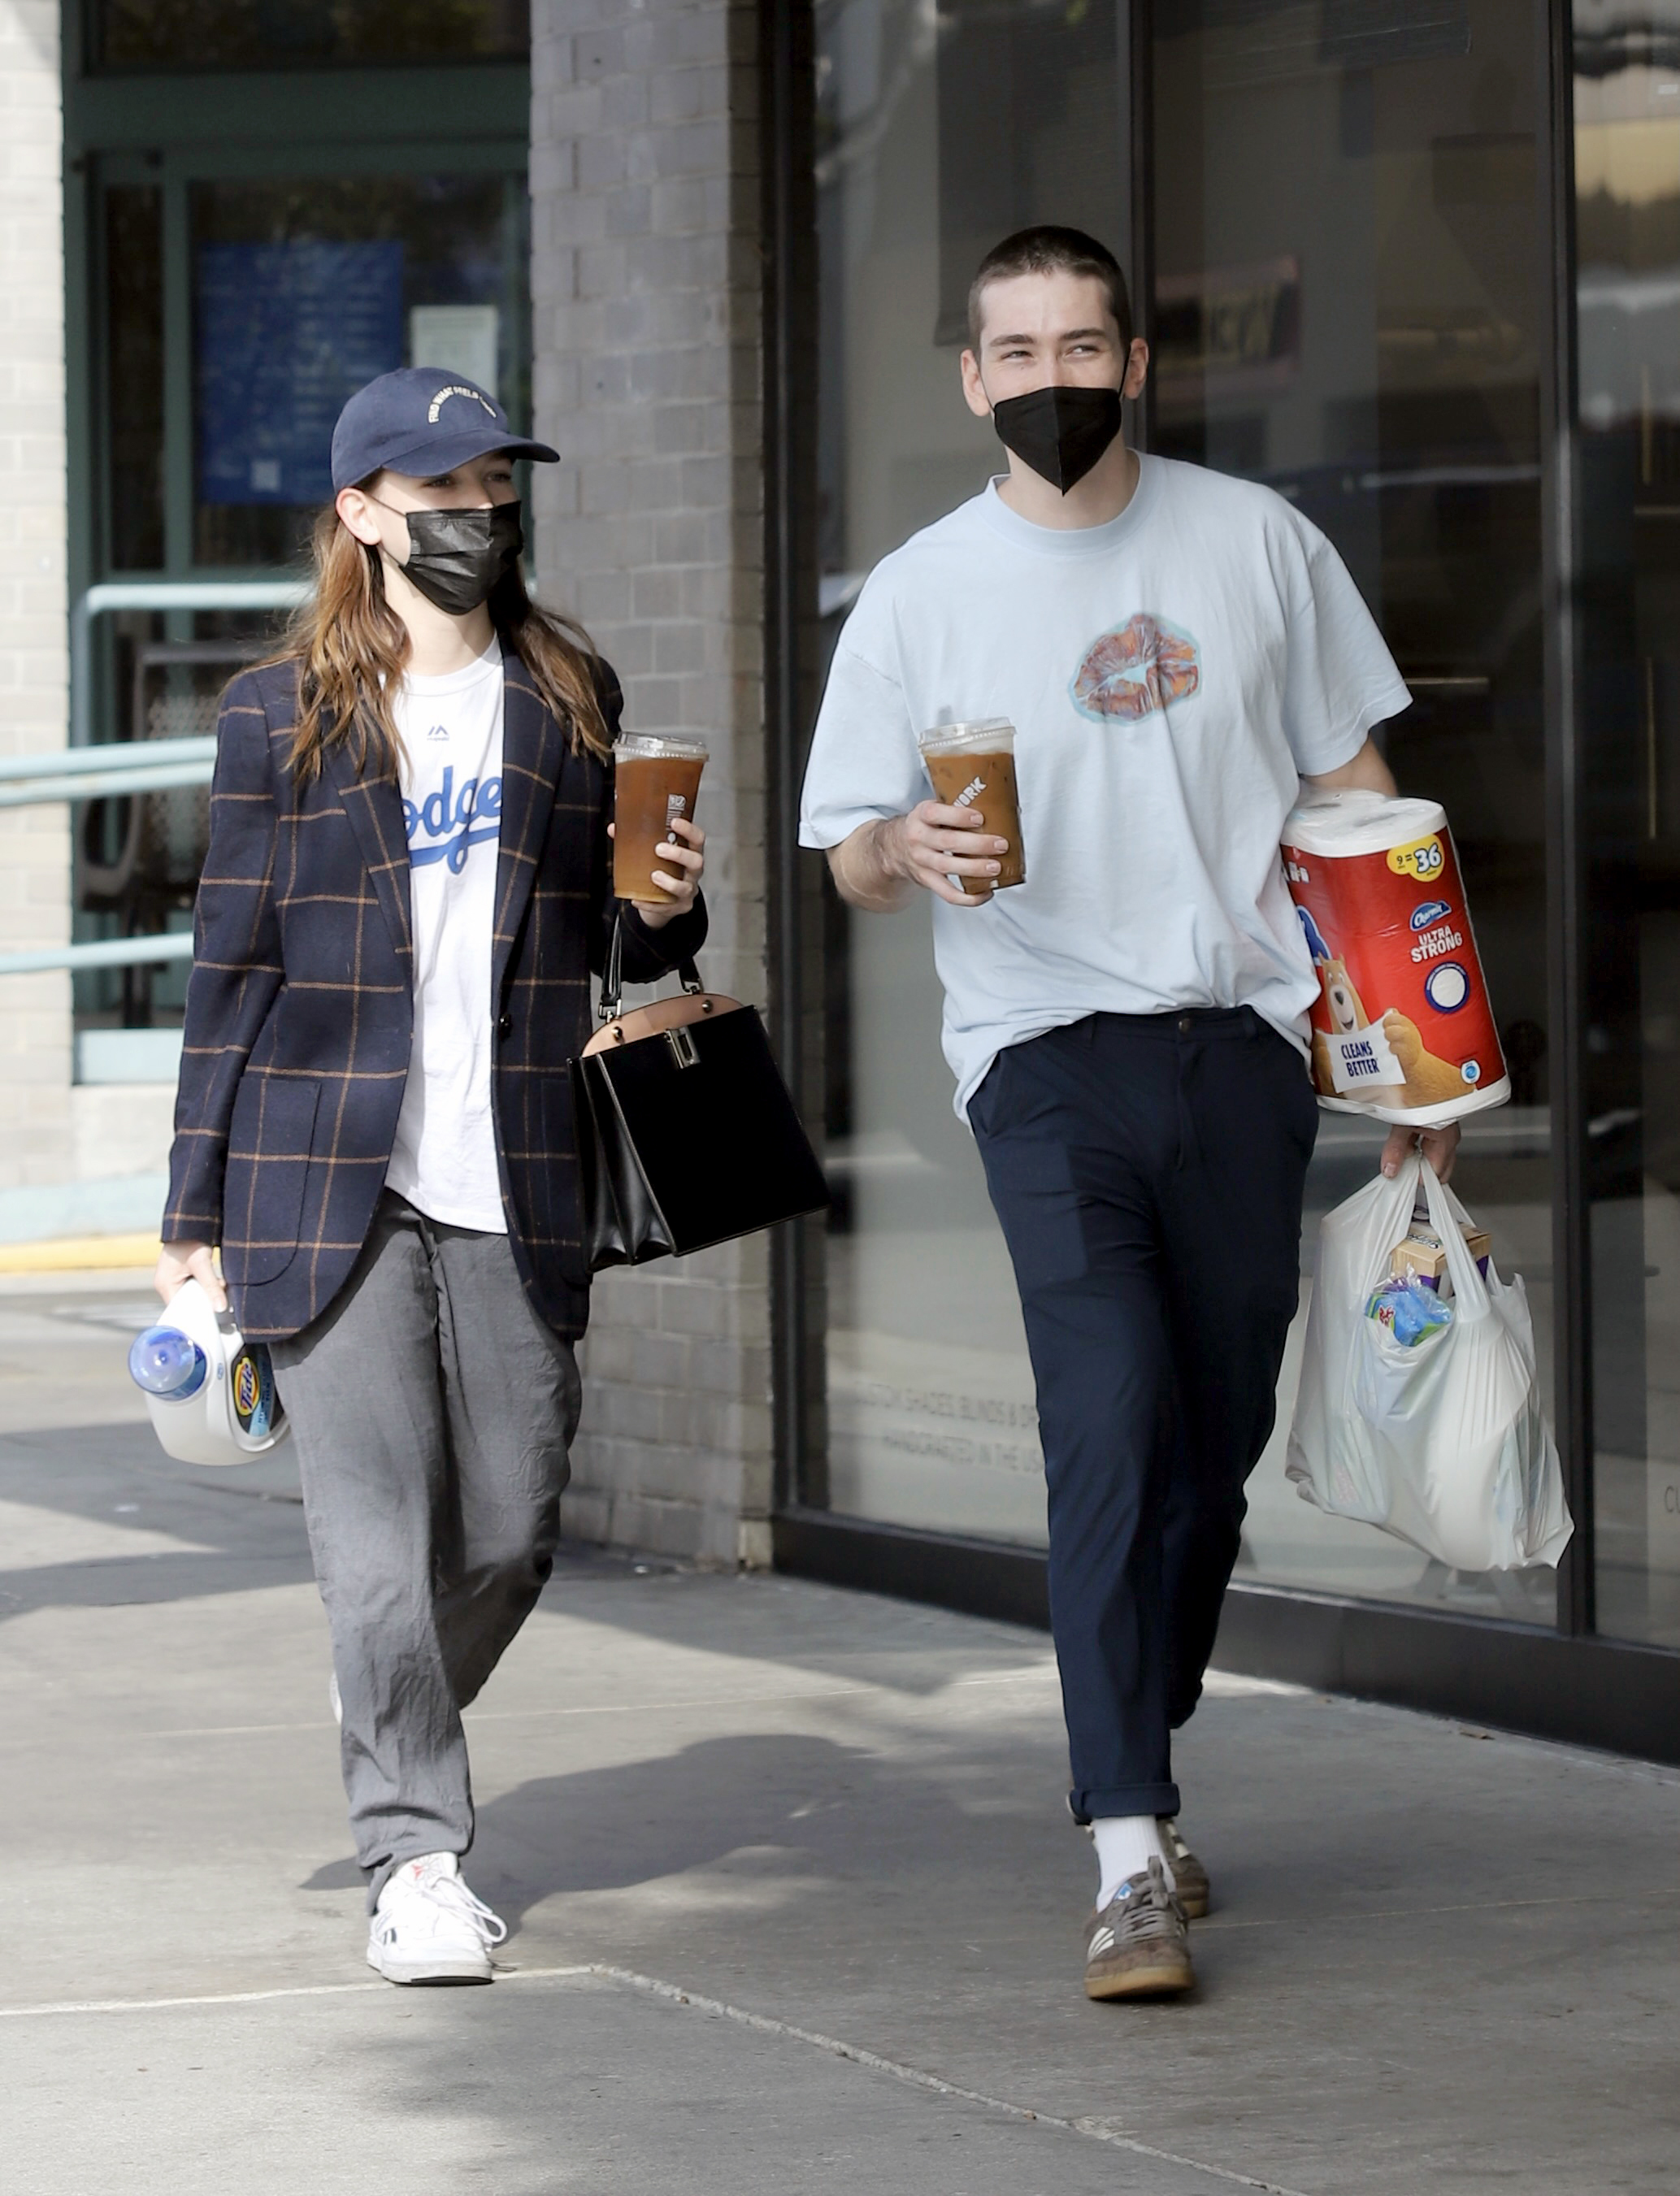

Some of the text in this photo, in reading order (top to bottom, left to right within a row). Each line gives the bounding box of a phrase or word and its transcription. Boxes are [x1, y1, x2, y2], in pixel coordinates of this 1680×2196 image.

[1396, 854, 1404, 866] 9
[1413, 841, 1443, 874] 36
[1410, 931, 1463, 963] STRONG
[1417, 925, 1452, 946] ULTRA
[1340, 1040, 1374, 1061] CLEANS
[1345, 1057, 1380, 1078] BETTER
[240, 1363, 254, 1412] Tide
